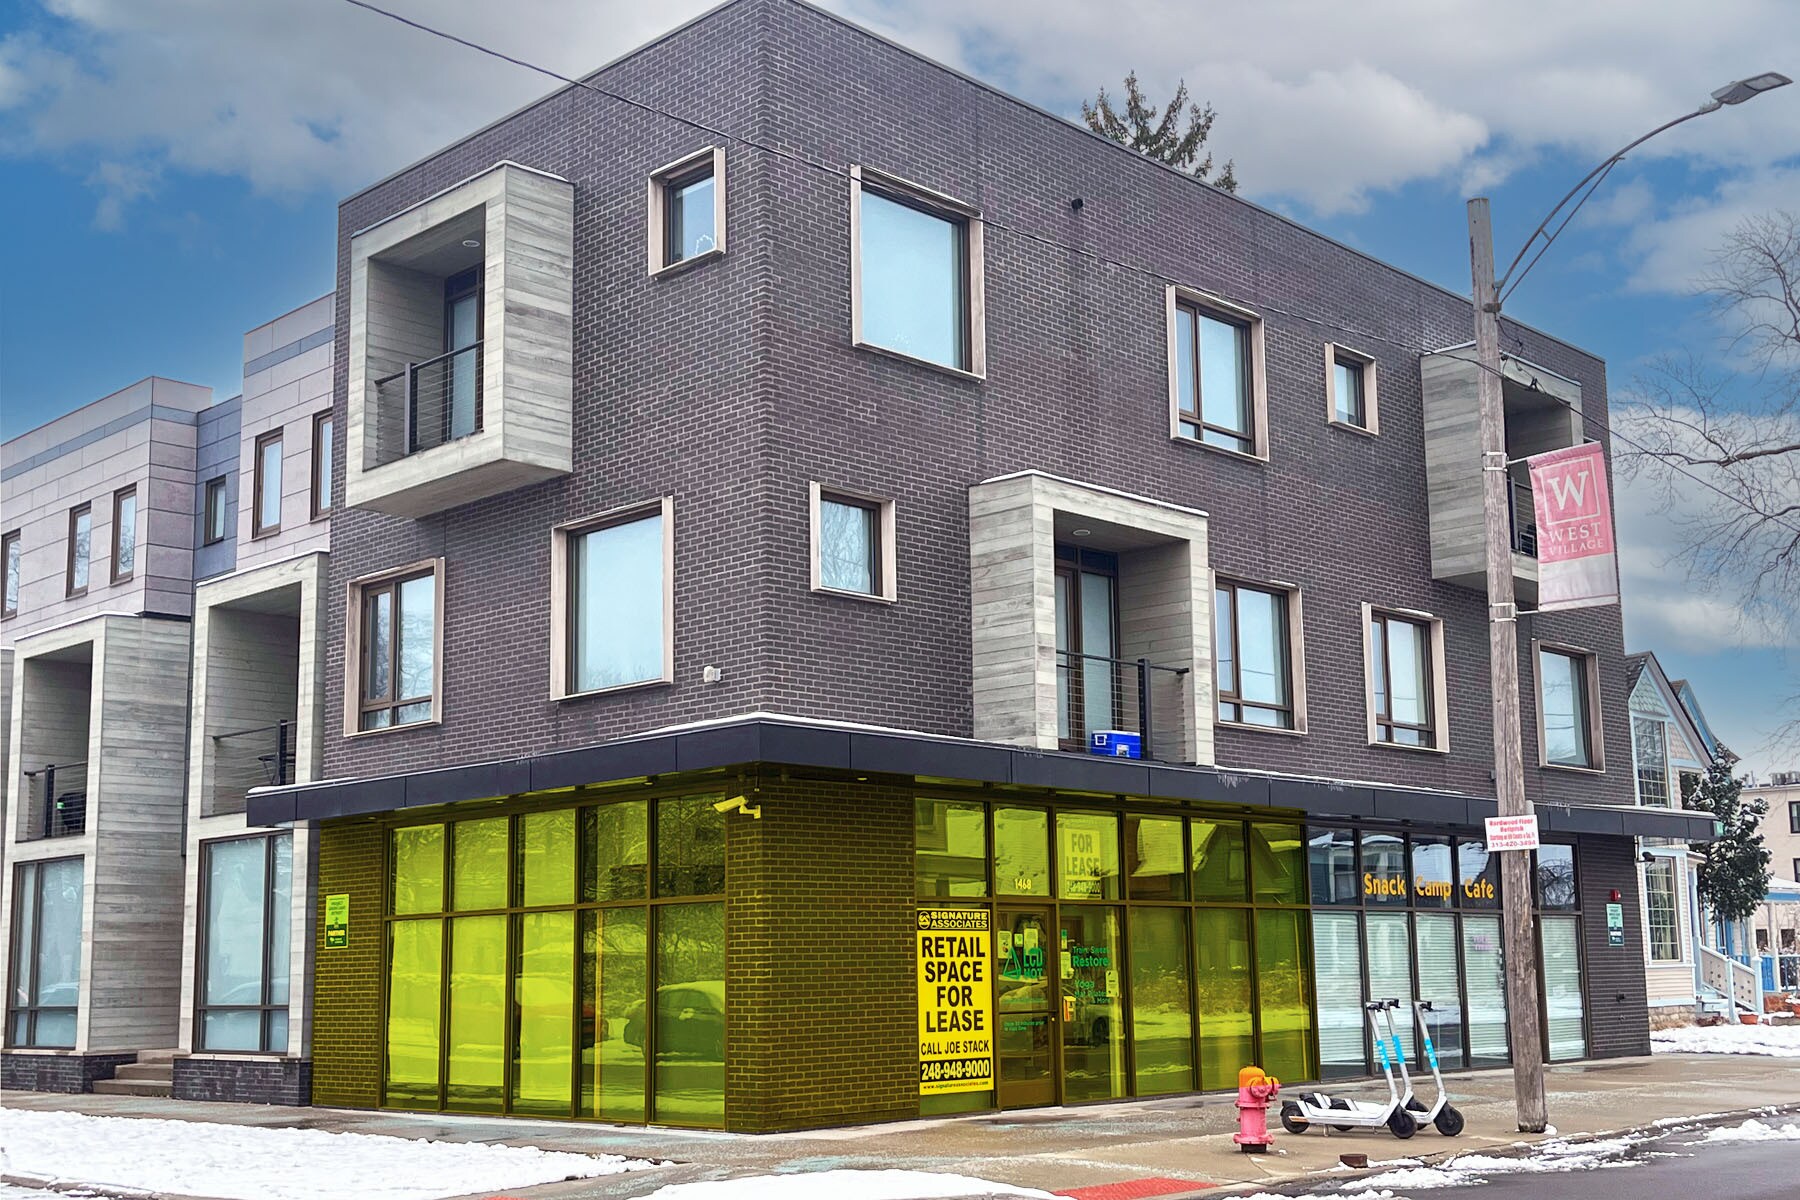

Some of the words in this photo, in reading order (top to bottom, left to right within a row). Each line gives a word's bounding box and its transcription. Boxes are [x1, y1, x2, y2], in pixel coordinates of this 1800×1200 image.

[1547, 470, 1589, 511] W
[1549, 522, 1601, 543] WEST
[1549, 539, 1604, 555] VILLAGE
[1071, 833, 1093, 853] FOR
[1066, 855, 1100, 877] LEASE
[1014, 878, 1032, 890] 1468
[1364, 872, 1406, 895] Snack
[1416, 875, 1452, 901] Camp
[1464, 877, 1494, 899] Cafe
[930, 911, 988, 920] SIGNATURE
[930, 920, 988, 928] ASSOCIATES
[922, 936, 985, 957] RETAIL
[925, 961, 983, 983] SPACE
[1073, 956, 1109, 967] Restore
[937, 985, 973, 1007] FOR
[926, 1010, 984, 1033] LEASE
[921, 1042, 942, 1055] CALL
[945, 1041, 960, 1054] JOE
[963, 1039, 989, 1053] STACK
[921, 1059, 990, 1081] 248-948-9000
